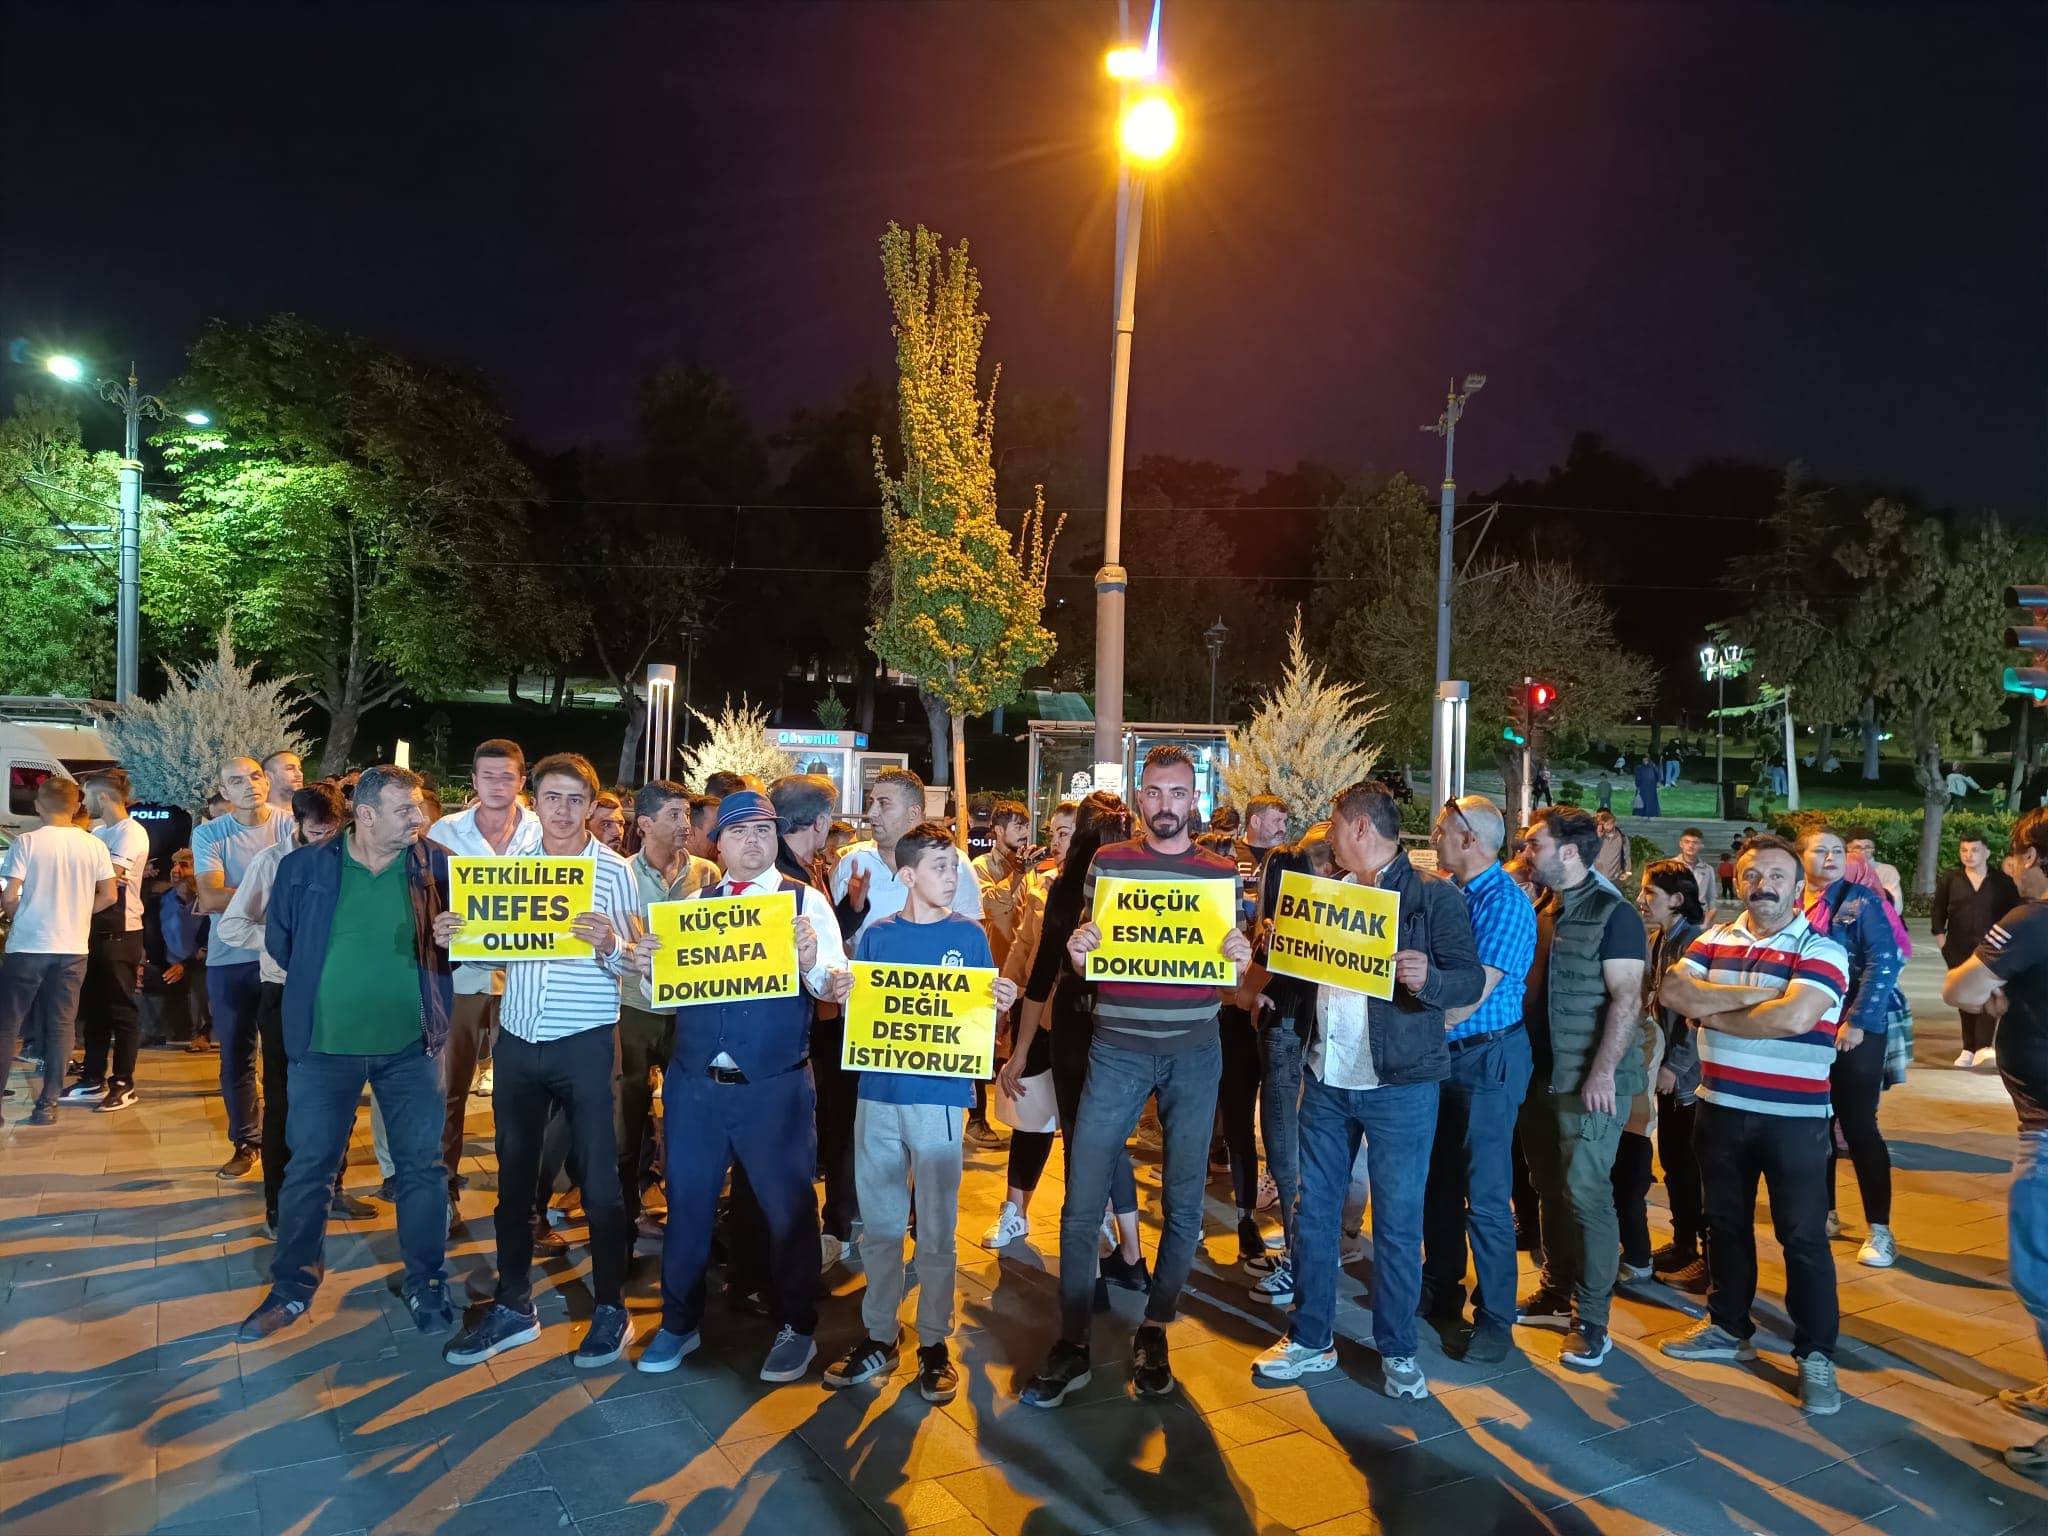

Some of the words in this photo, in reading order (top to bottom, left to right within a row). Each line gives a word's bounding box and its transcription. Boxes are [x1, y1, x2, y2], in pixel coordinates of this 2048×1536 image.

[778, 731, 839, 745] Güvenlik
[456, 862, 584, 885] YETKİLİLER
[467, 895, 570, 922] NEFES
[1117, 888, 1200, 917] KÜÇÜK
[679, 904, 761, 935] KÜÇÜK
[1279, 894, 1387, 939] BATMAK
[483, 932, 554, 951] OLUN!
[1112, 925, 1204, 945] ESNAFA
[677, 942, 767, 966] ESNAFA
[1270, 928, 1390, 978] İSTEMİYORUZ!
[1093, 956, 1225, 979] DOKUNMA!
[658, 974, 788, 1002] DOKUNMA!
[870, 969, 970, 993] SADAKA
[884, 992, 953, 1018] DEĞİL
[872, 1020, 961, 1045] DESTEK
[848, 1041, 982, 1075] İSTİYORUZ!
